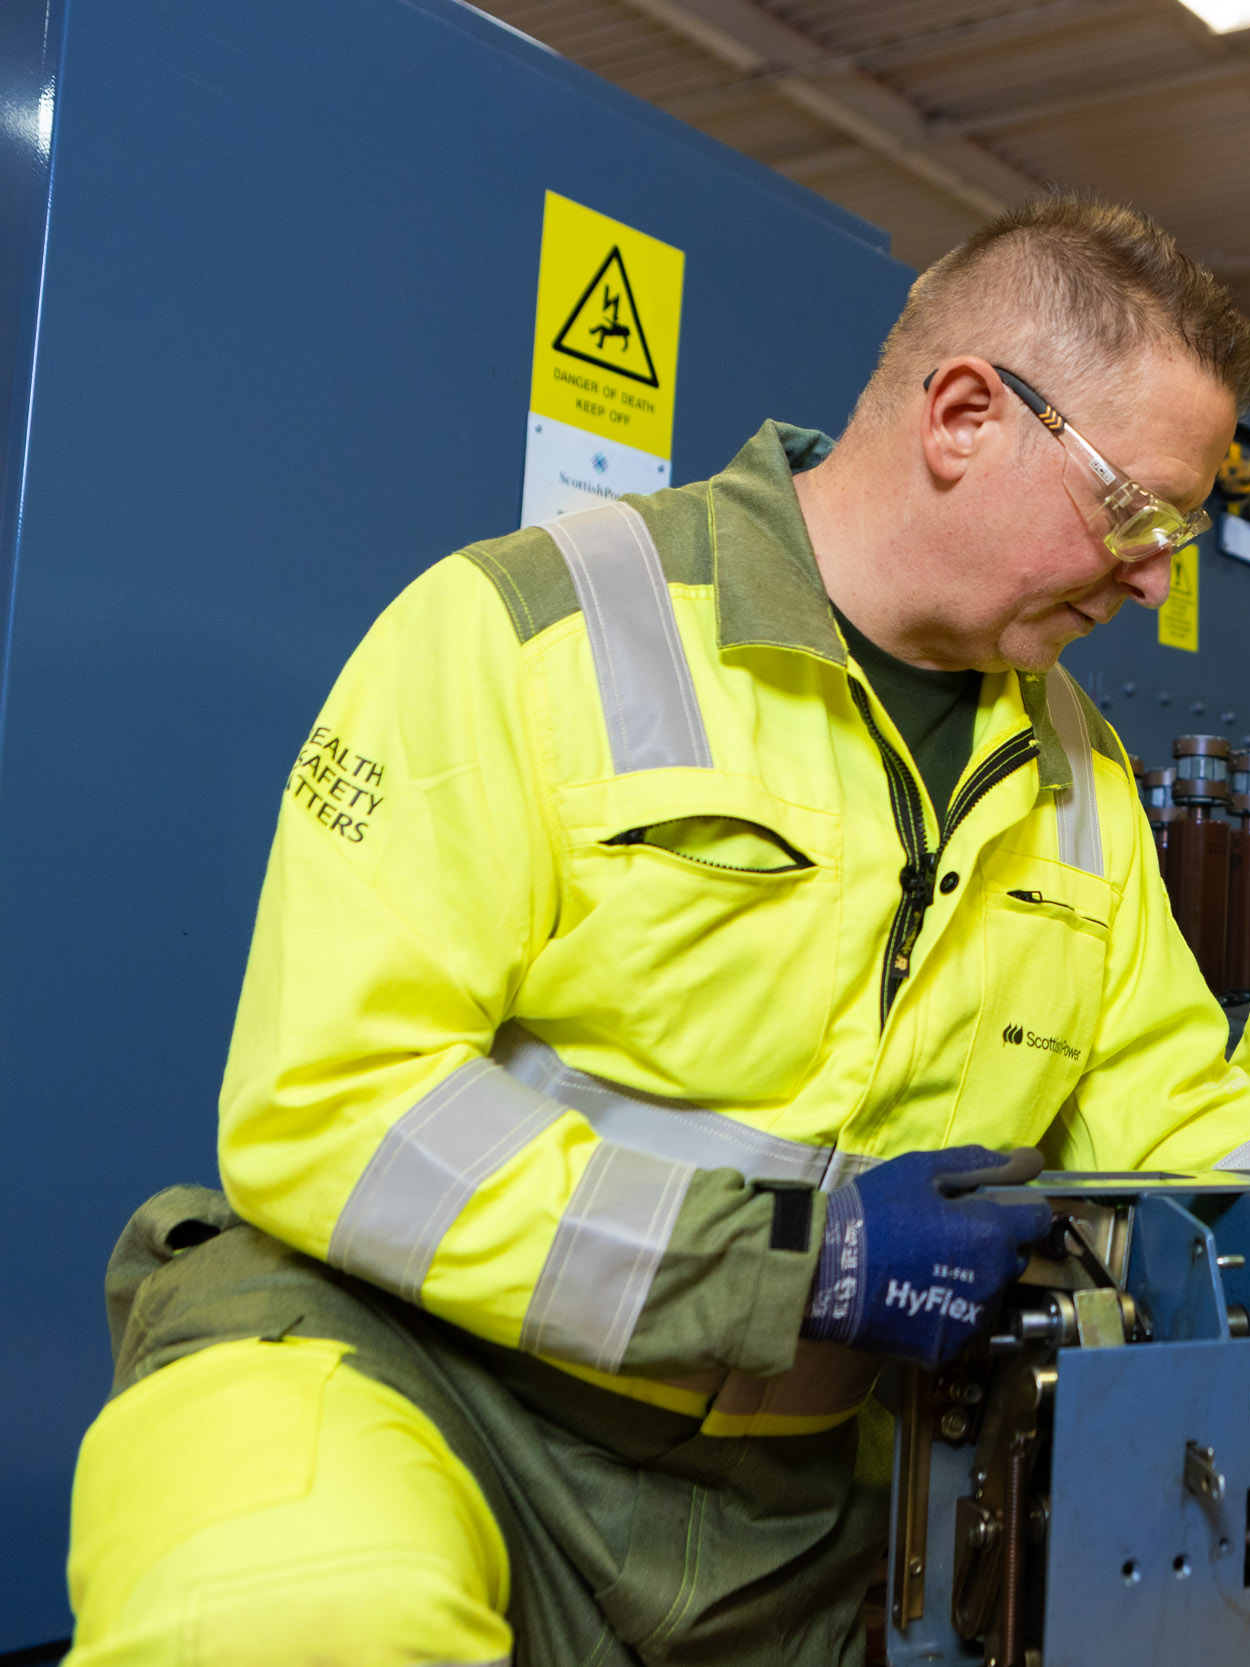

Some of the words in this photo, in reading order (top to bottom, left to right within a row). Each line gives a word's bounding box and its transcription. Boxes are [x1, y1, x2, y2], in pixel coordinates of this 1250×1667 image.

[553, 367, 599, 393] DANGER
[602, 384, 618, 399] OF
[621, 390, 655, 414] DEATH
[575, 398, 605, 417] KEEP
[609, 410, 631, 426] OFF
[309, 726, 385, 787] EALTH
[286, 773, 369, 844] TTERS
[885, 1278, 982, 1326] HyFlex
